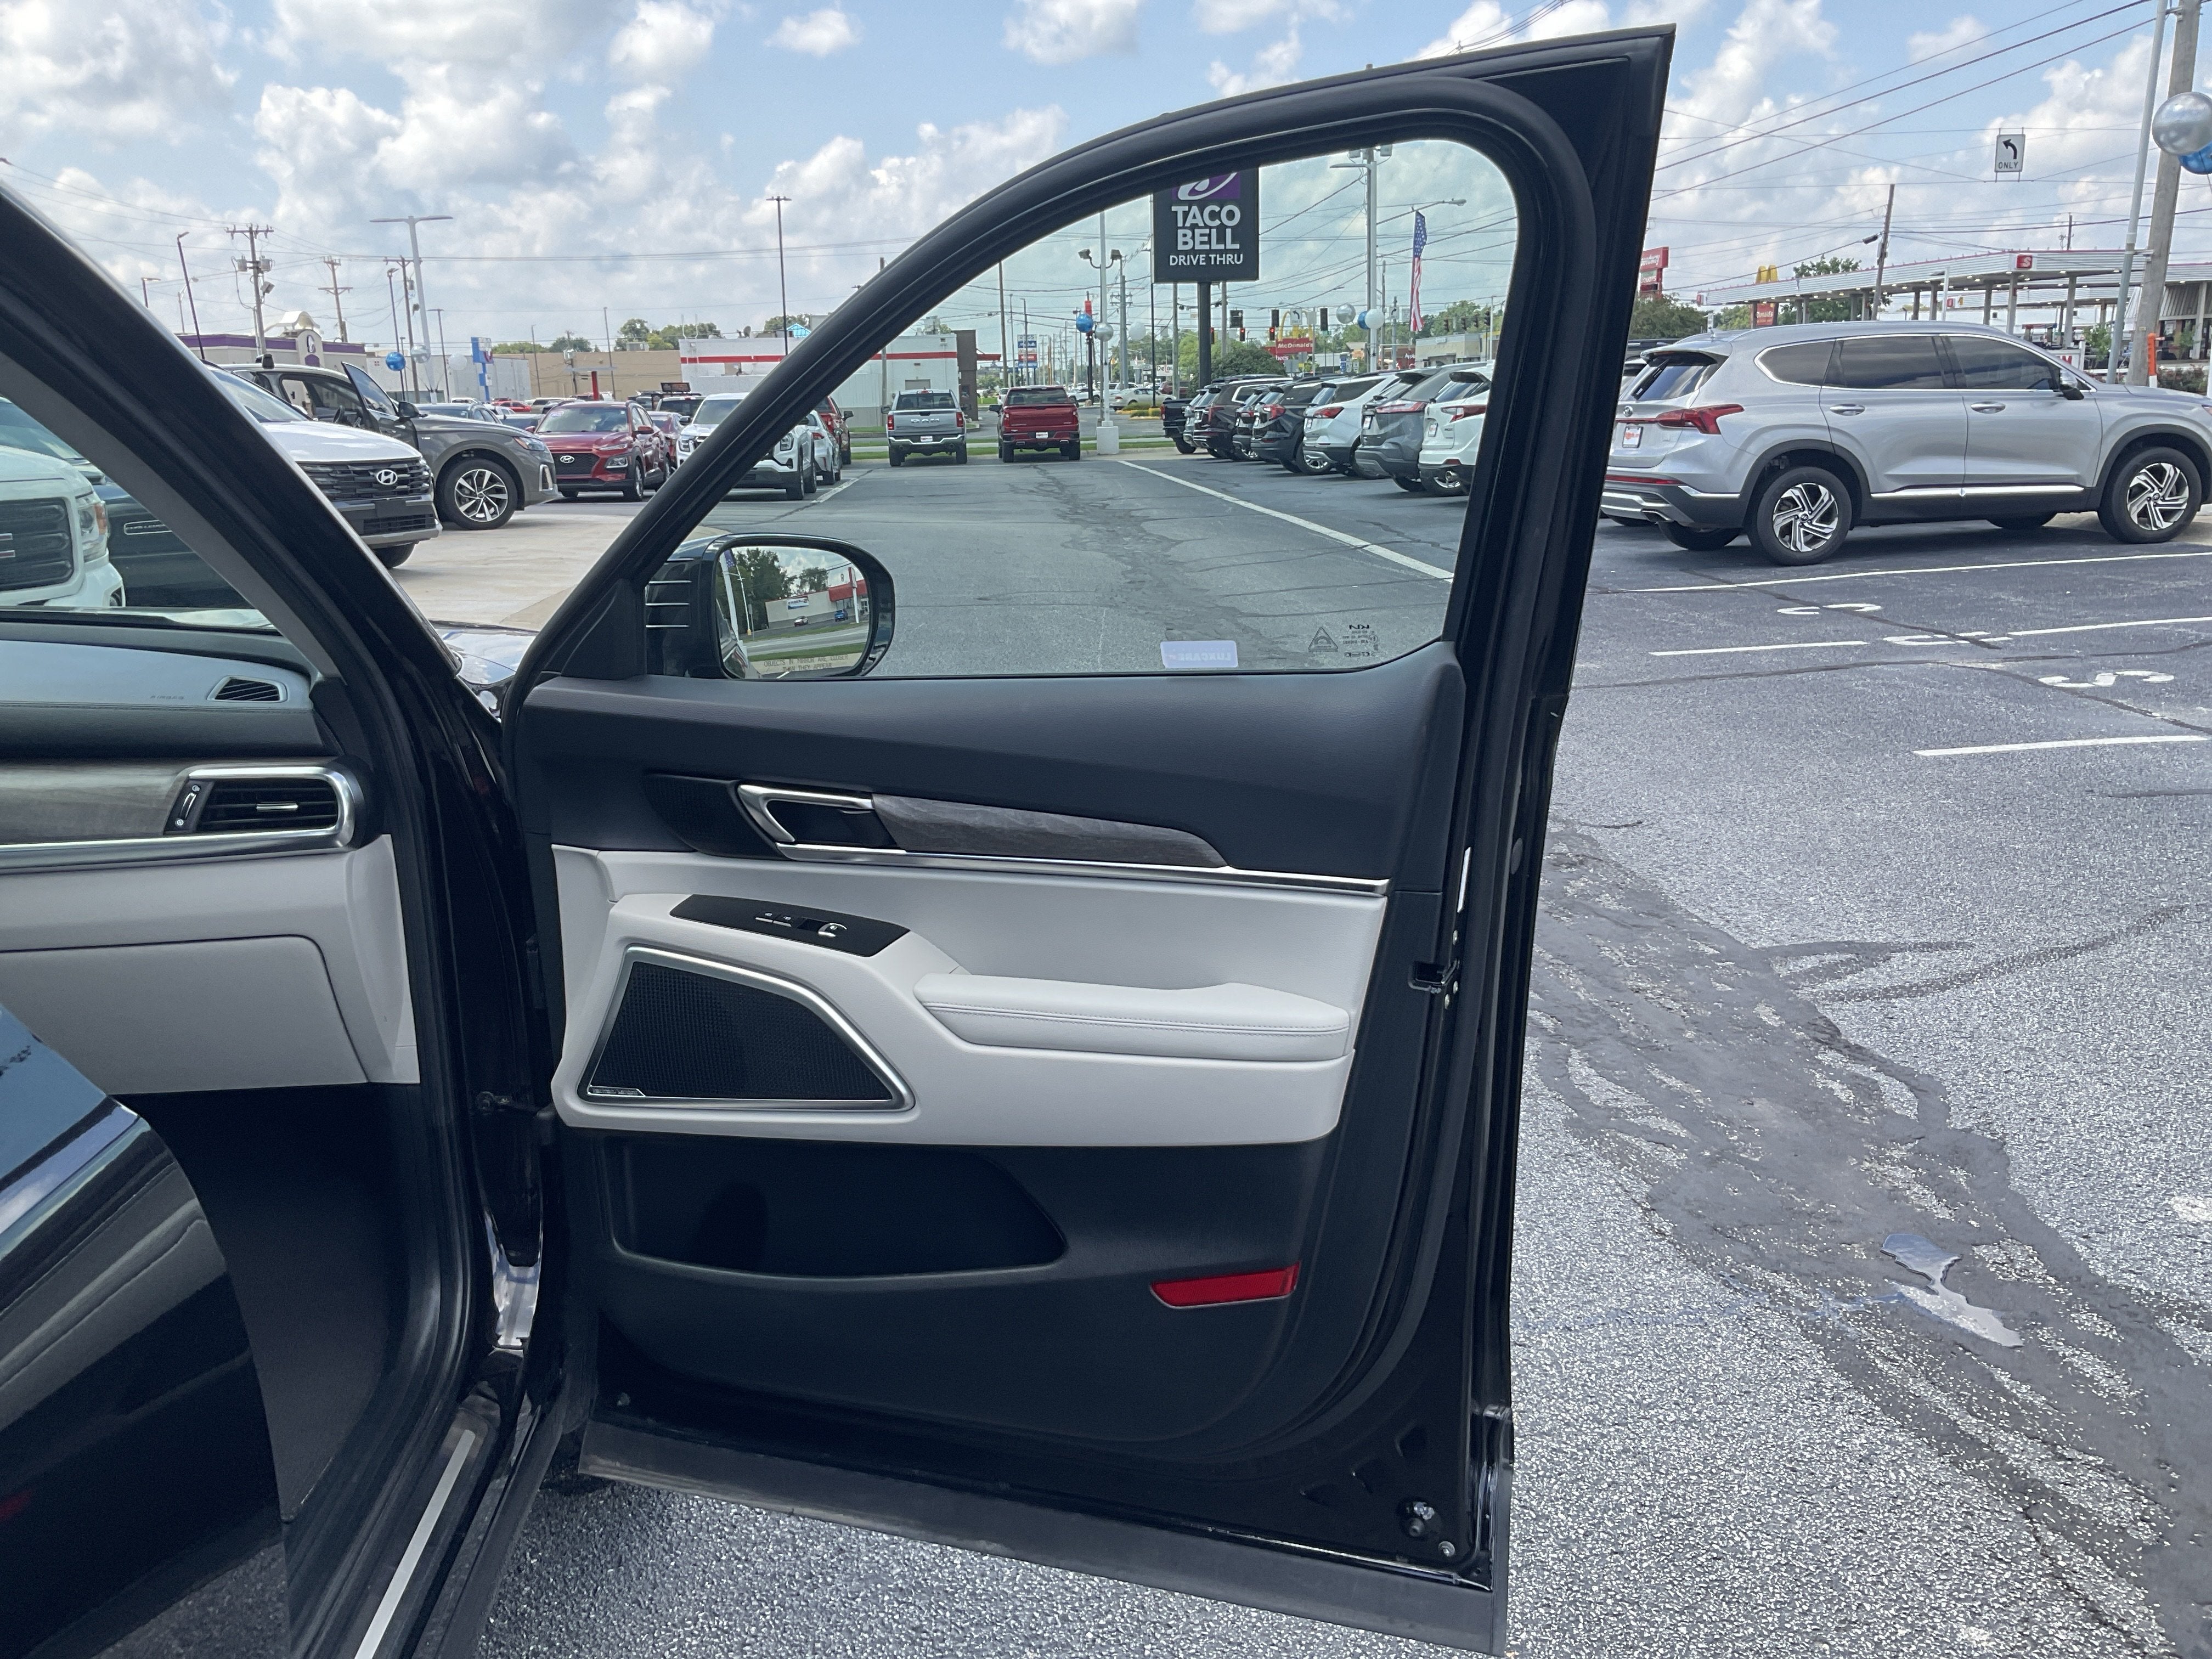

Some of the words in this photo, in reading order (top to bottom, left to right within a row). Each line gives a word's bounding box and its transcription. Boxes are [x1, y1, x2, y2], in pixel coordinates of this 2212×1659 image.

[1171, 205, 1241, 227] TACO
[1177, 228, 1240, 251] BELL
[1169, 254, 1206, 266] DRIVE
[1209, 253, 1244, 265] THRU
